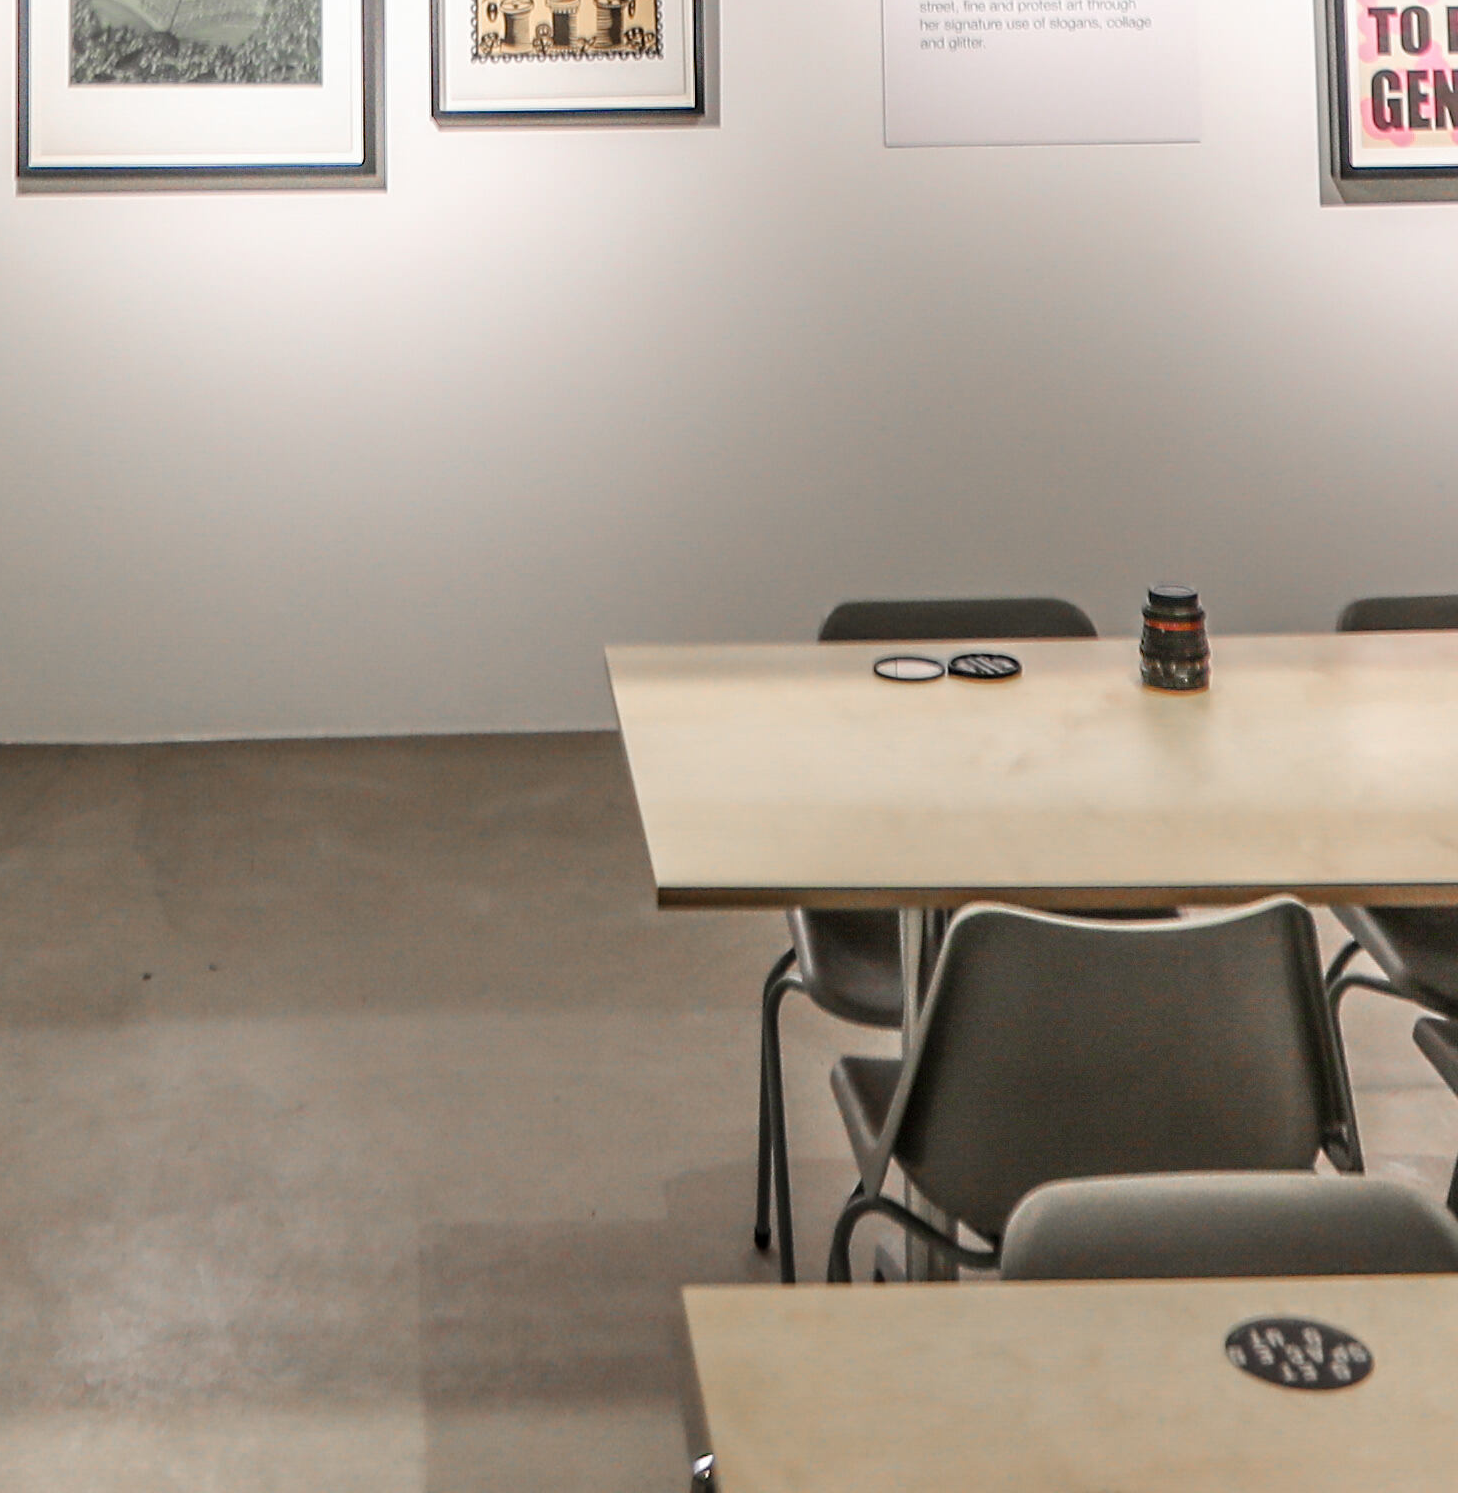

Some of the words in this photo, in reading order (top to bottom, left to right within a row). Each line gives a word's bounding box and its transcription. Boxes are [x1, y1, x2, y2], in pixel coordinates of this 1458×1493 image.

[962, 0, 986, 13] fine
[988, 0, 1014, 12] and
[1017, 0, 1062, 15] protest
[919, 18, 941, 30] her
[943, 17, 1003, 32] signature
[1005, 19, 1030, 29] use
[1032, 16, 1046, 29] of
[1105, 15, 1152, 31] collage
[1367, 5, 1432, 55] TO
[919, 36, 945, 49] and
